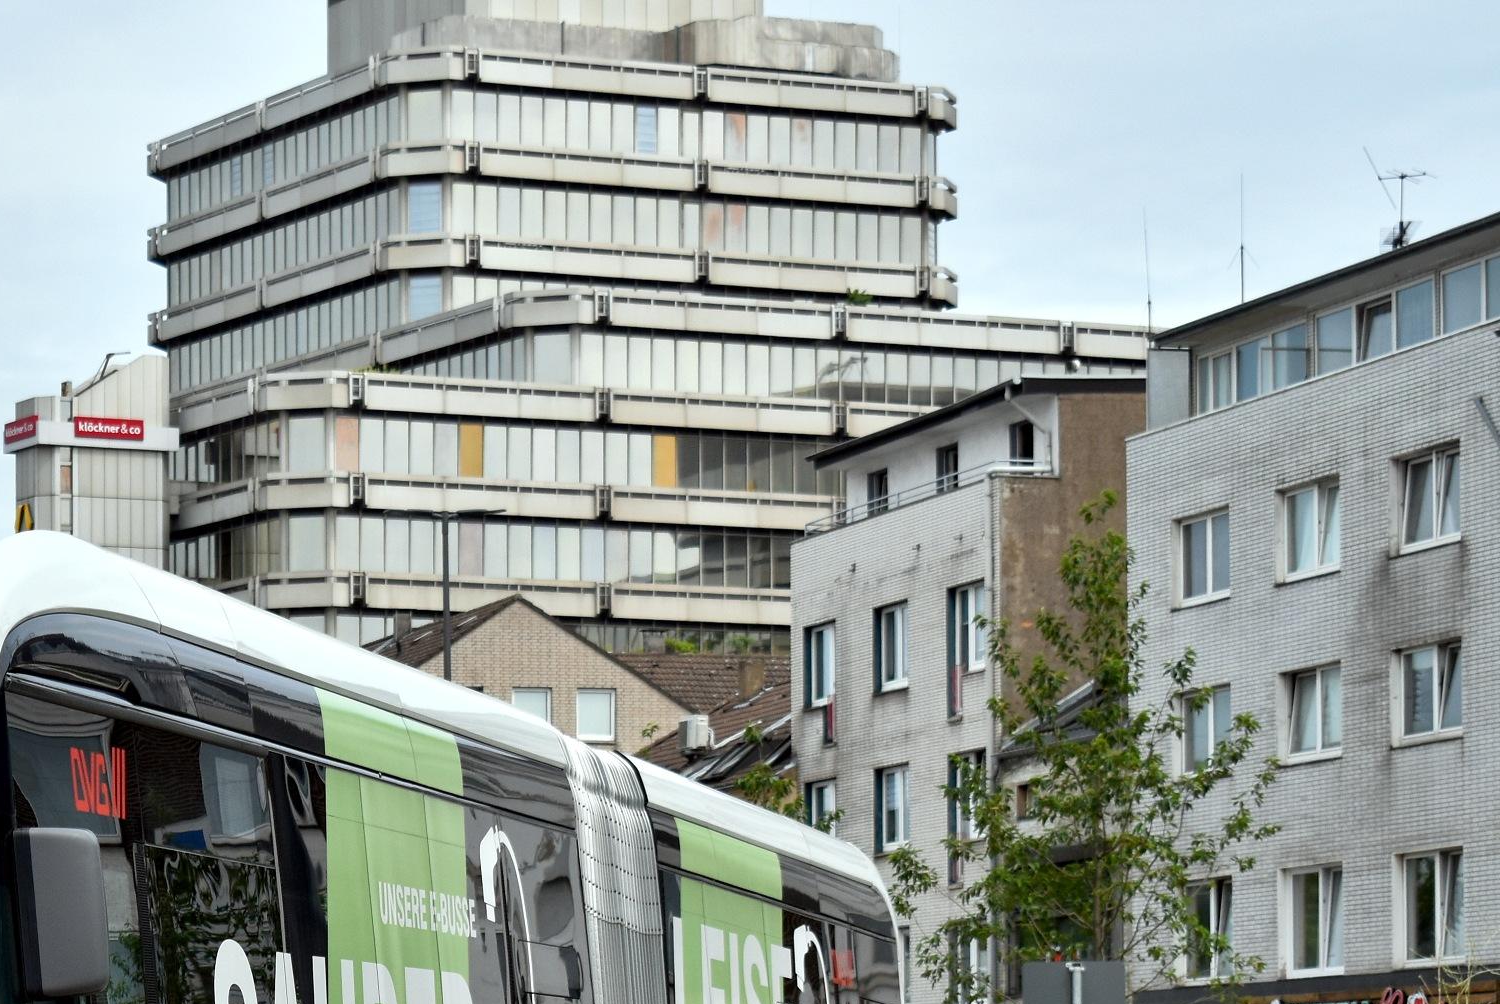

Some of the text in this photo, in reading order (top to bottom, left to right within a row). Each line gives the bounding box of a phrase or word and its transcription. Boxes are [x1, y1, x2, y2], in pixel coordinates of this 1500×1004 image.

[78, 421, 141, 435] klöckner & co
[69, 746, 111, 817] DVG
[378, 881, 477, 938] UNSERE E-BUSSE
